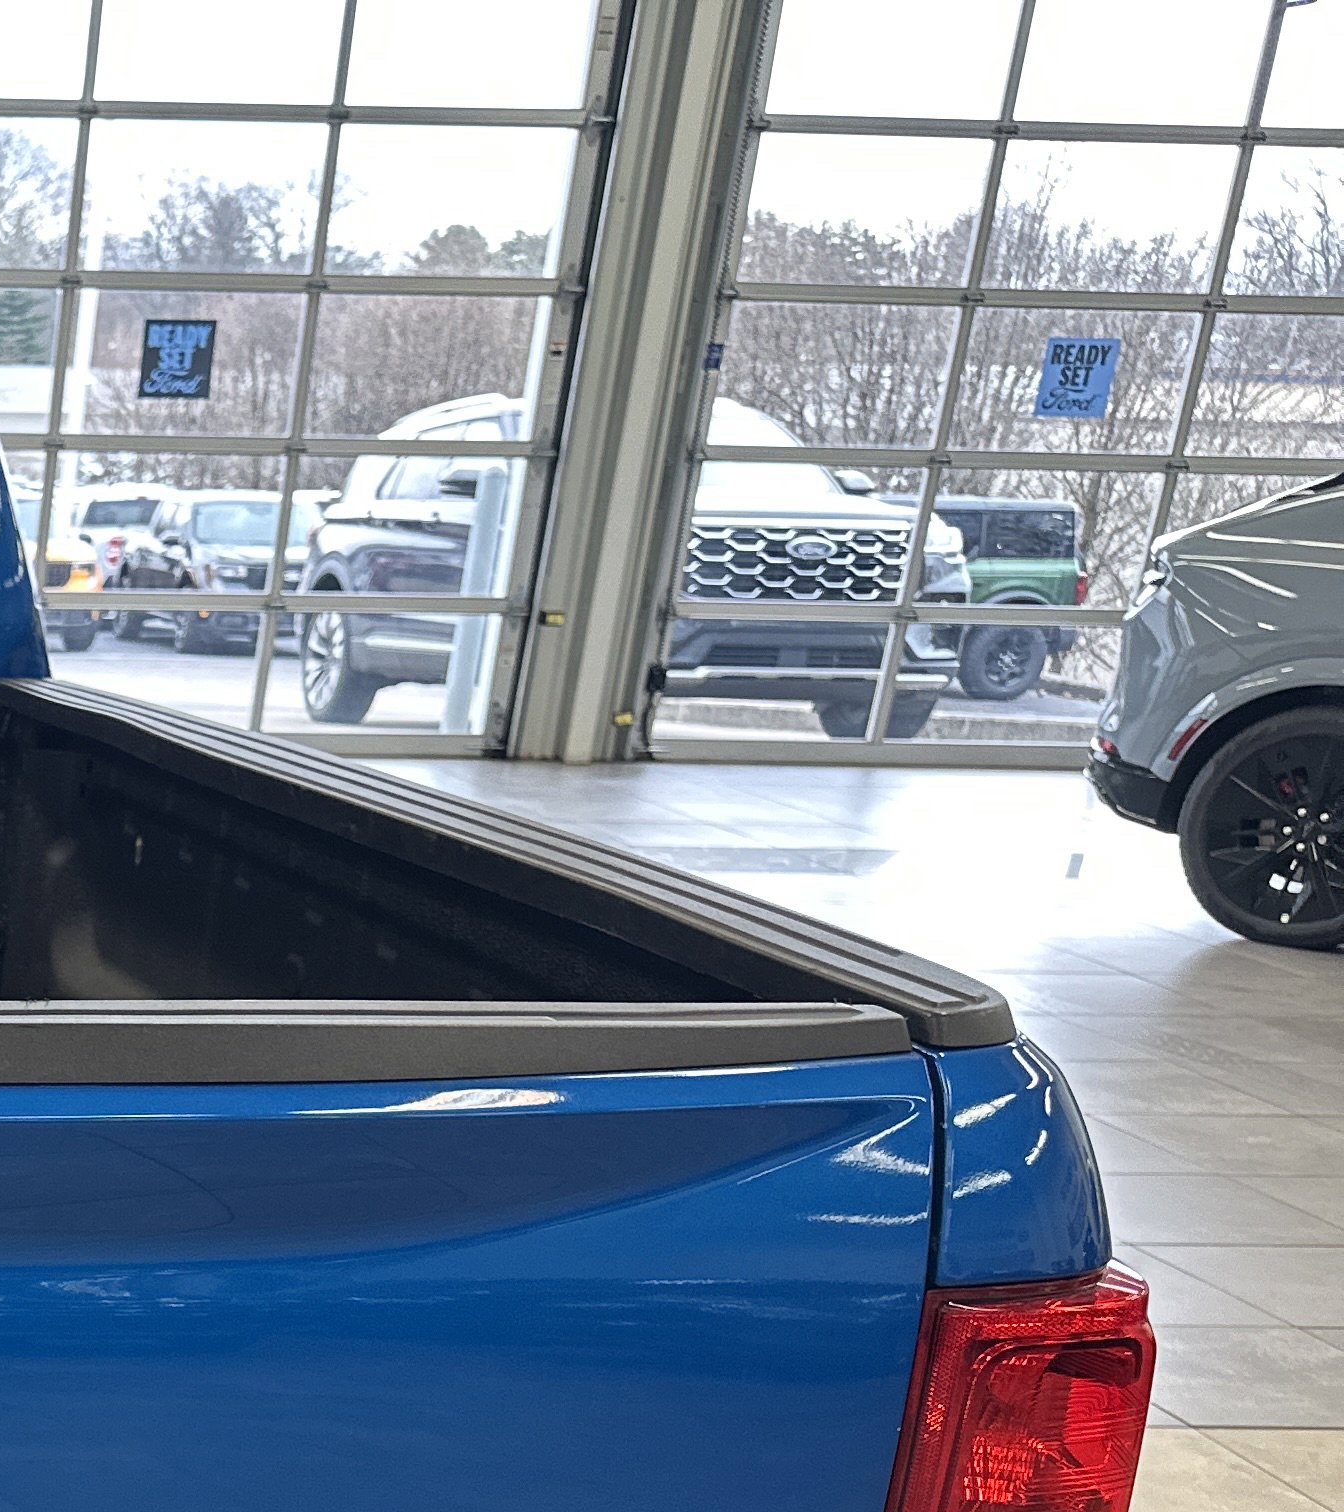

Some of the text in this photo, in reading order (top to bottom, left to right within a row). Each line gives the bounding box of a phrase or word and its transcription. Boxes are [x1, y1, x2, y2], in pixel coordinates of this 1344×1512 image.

[147, 324, 212, 349] READY
[158, 347, 197, 371] SET
[1050, 343, 1113, 366] READY
[143, 369, 204, 394] Ford
[1059, 365, 1094, 387] SET
[1041, 387, 1102, 411] Ford
